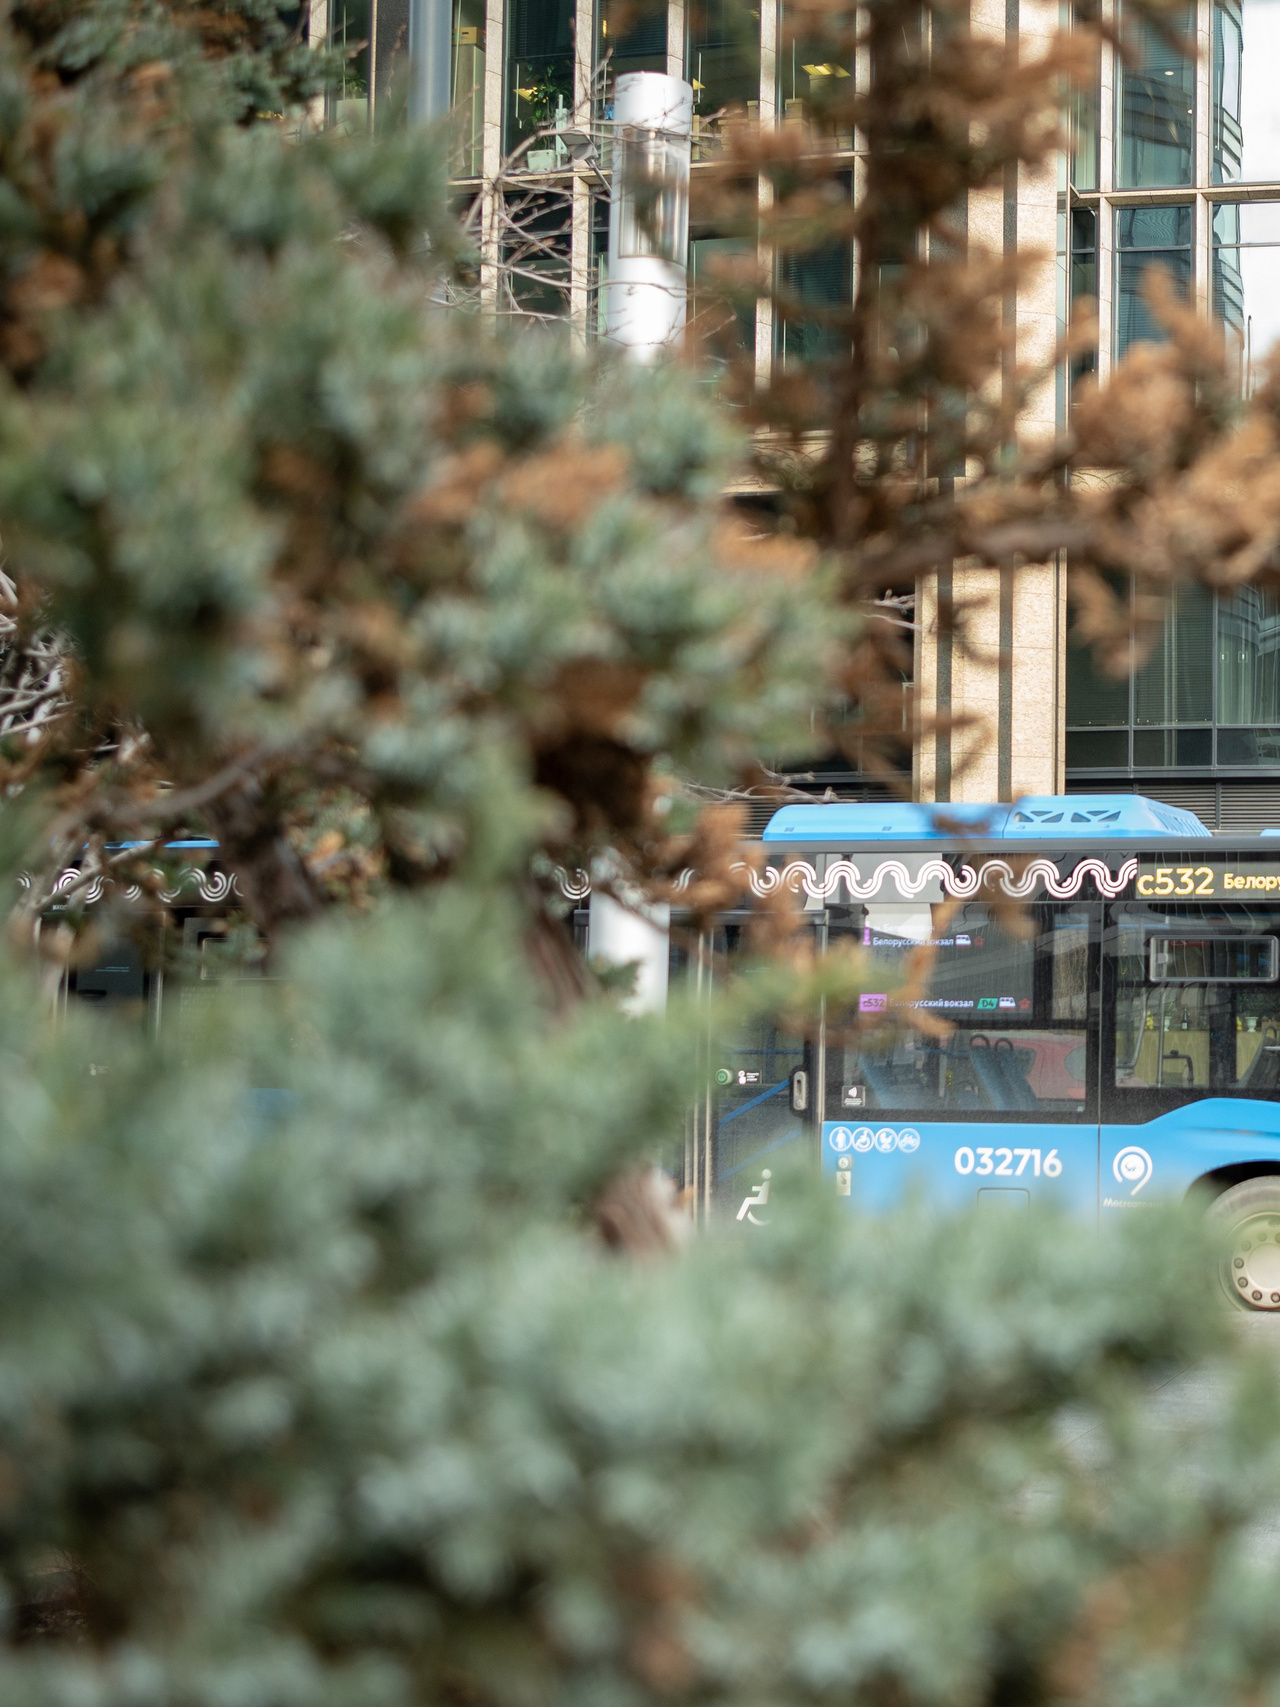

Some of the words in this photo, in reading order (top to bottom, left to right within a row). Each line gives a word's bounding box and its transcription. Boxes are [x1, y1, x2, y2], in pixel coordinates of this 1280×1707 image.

[1137, 867, 1215, 895] с532
[862, 998, 886, 1008] с532
[944, 999, 974, 1008] вокзал
[954, 1146, 1063, 1178] 032716
